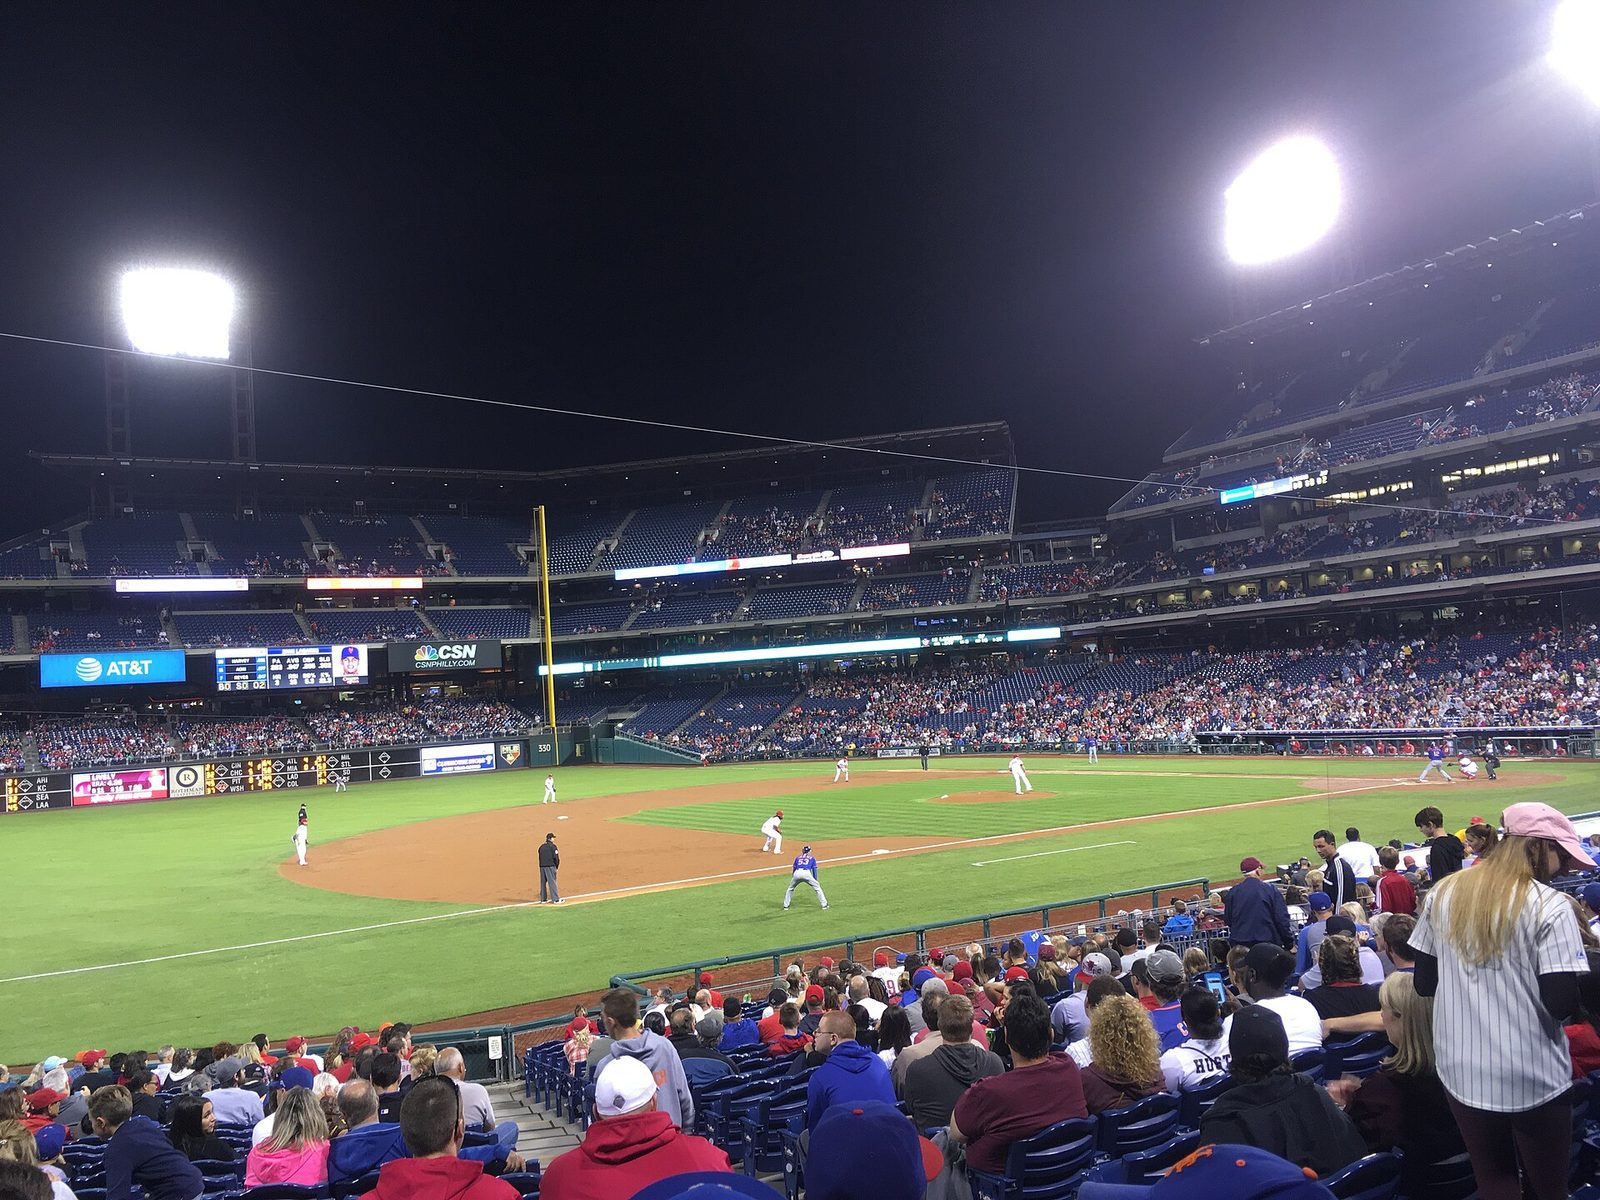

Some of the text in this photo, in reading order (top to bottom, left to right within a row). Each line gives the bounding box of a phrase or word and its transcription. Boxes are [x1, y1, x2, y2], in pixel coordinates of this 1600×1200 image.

[438, 644, 477, 659] CSN
[106, 659, 153, 676] AT&T
[415, 660, 476, 669] CSNPHILLY.COM
[538, 744, 551, 753] 330
[230, 769, 243, 777] CHC
[231, 777, 241, 785] PIT
[797, 858, 810, 866] 53
[886, 979, 897, 996] 9
